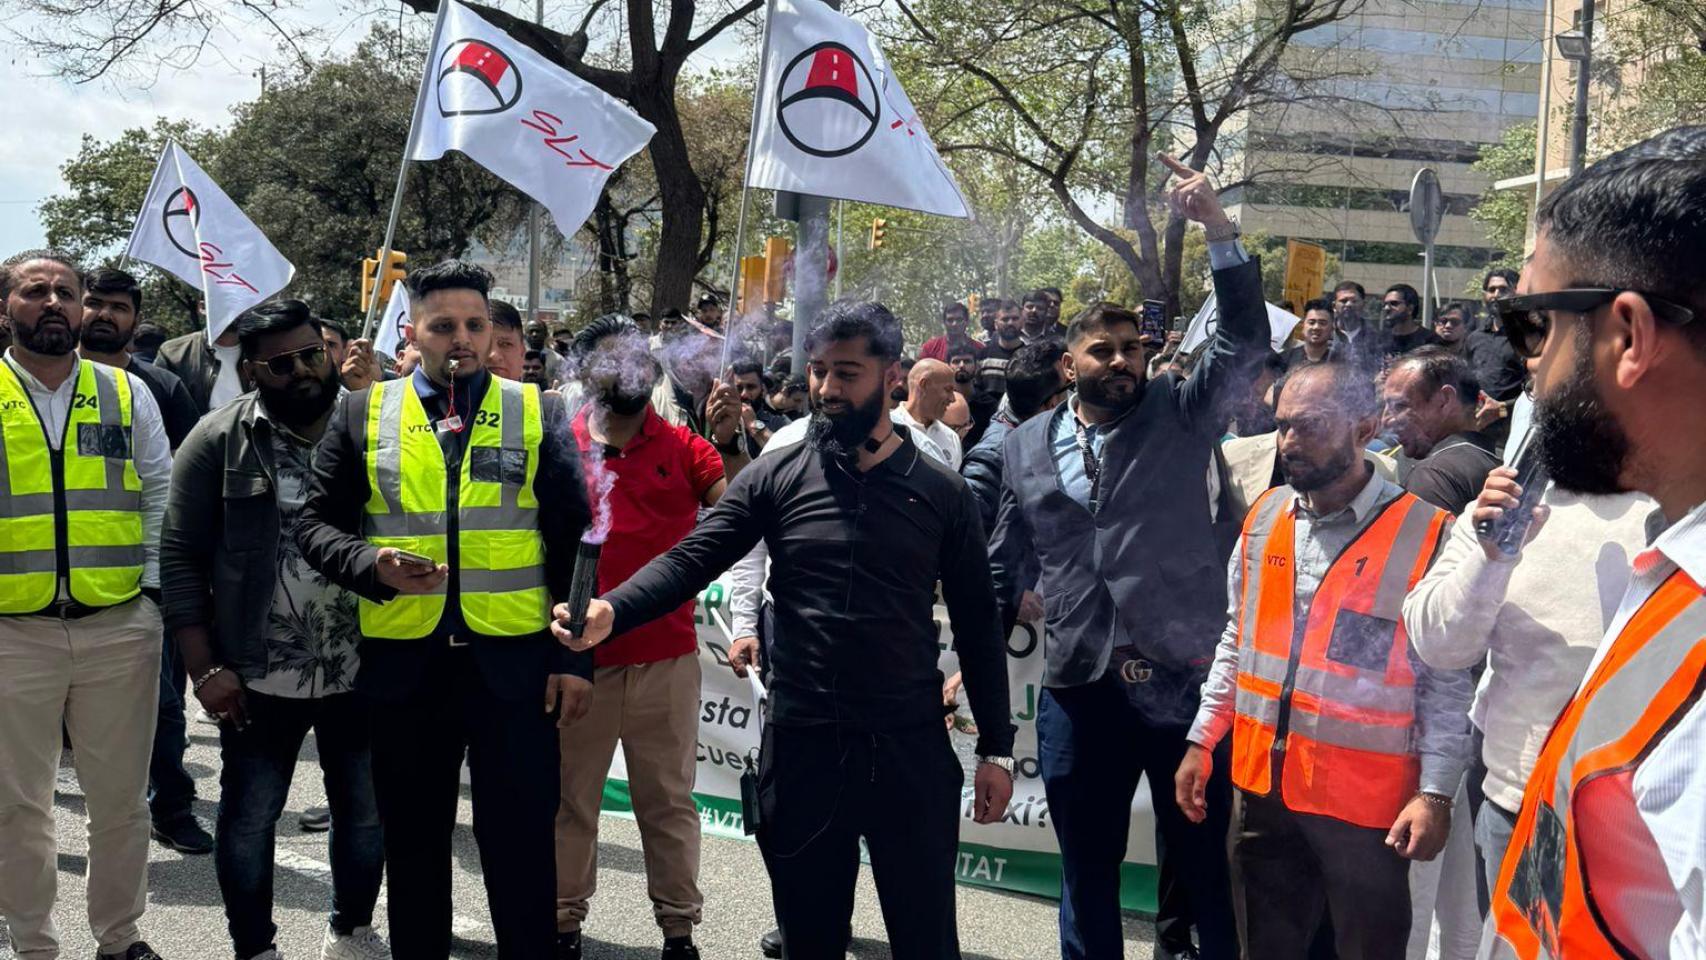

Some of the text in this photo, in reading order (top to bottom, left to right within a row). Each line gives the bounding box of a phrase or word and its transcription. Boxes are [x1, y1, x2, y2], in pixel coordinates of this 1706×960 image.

[521, 110, 614, 170] SLT
[2, 400, 26, 410] VTC
[75, 393, 97, 409] 24
[476, 410, 501, 428] 32
[408, 424, 432, 433] VTC
[1267, 555, 1286, 567] VTC
[1355, 556, 1368, 577] 1
[700, 697, 750, 729] sta
[700, 806, 743, 832] #VT
